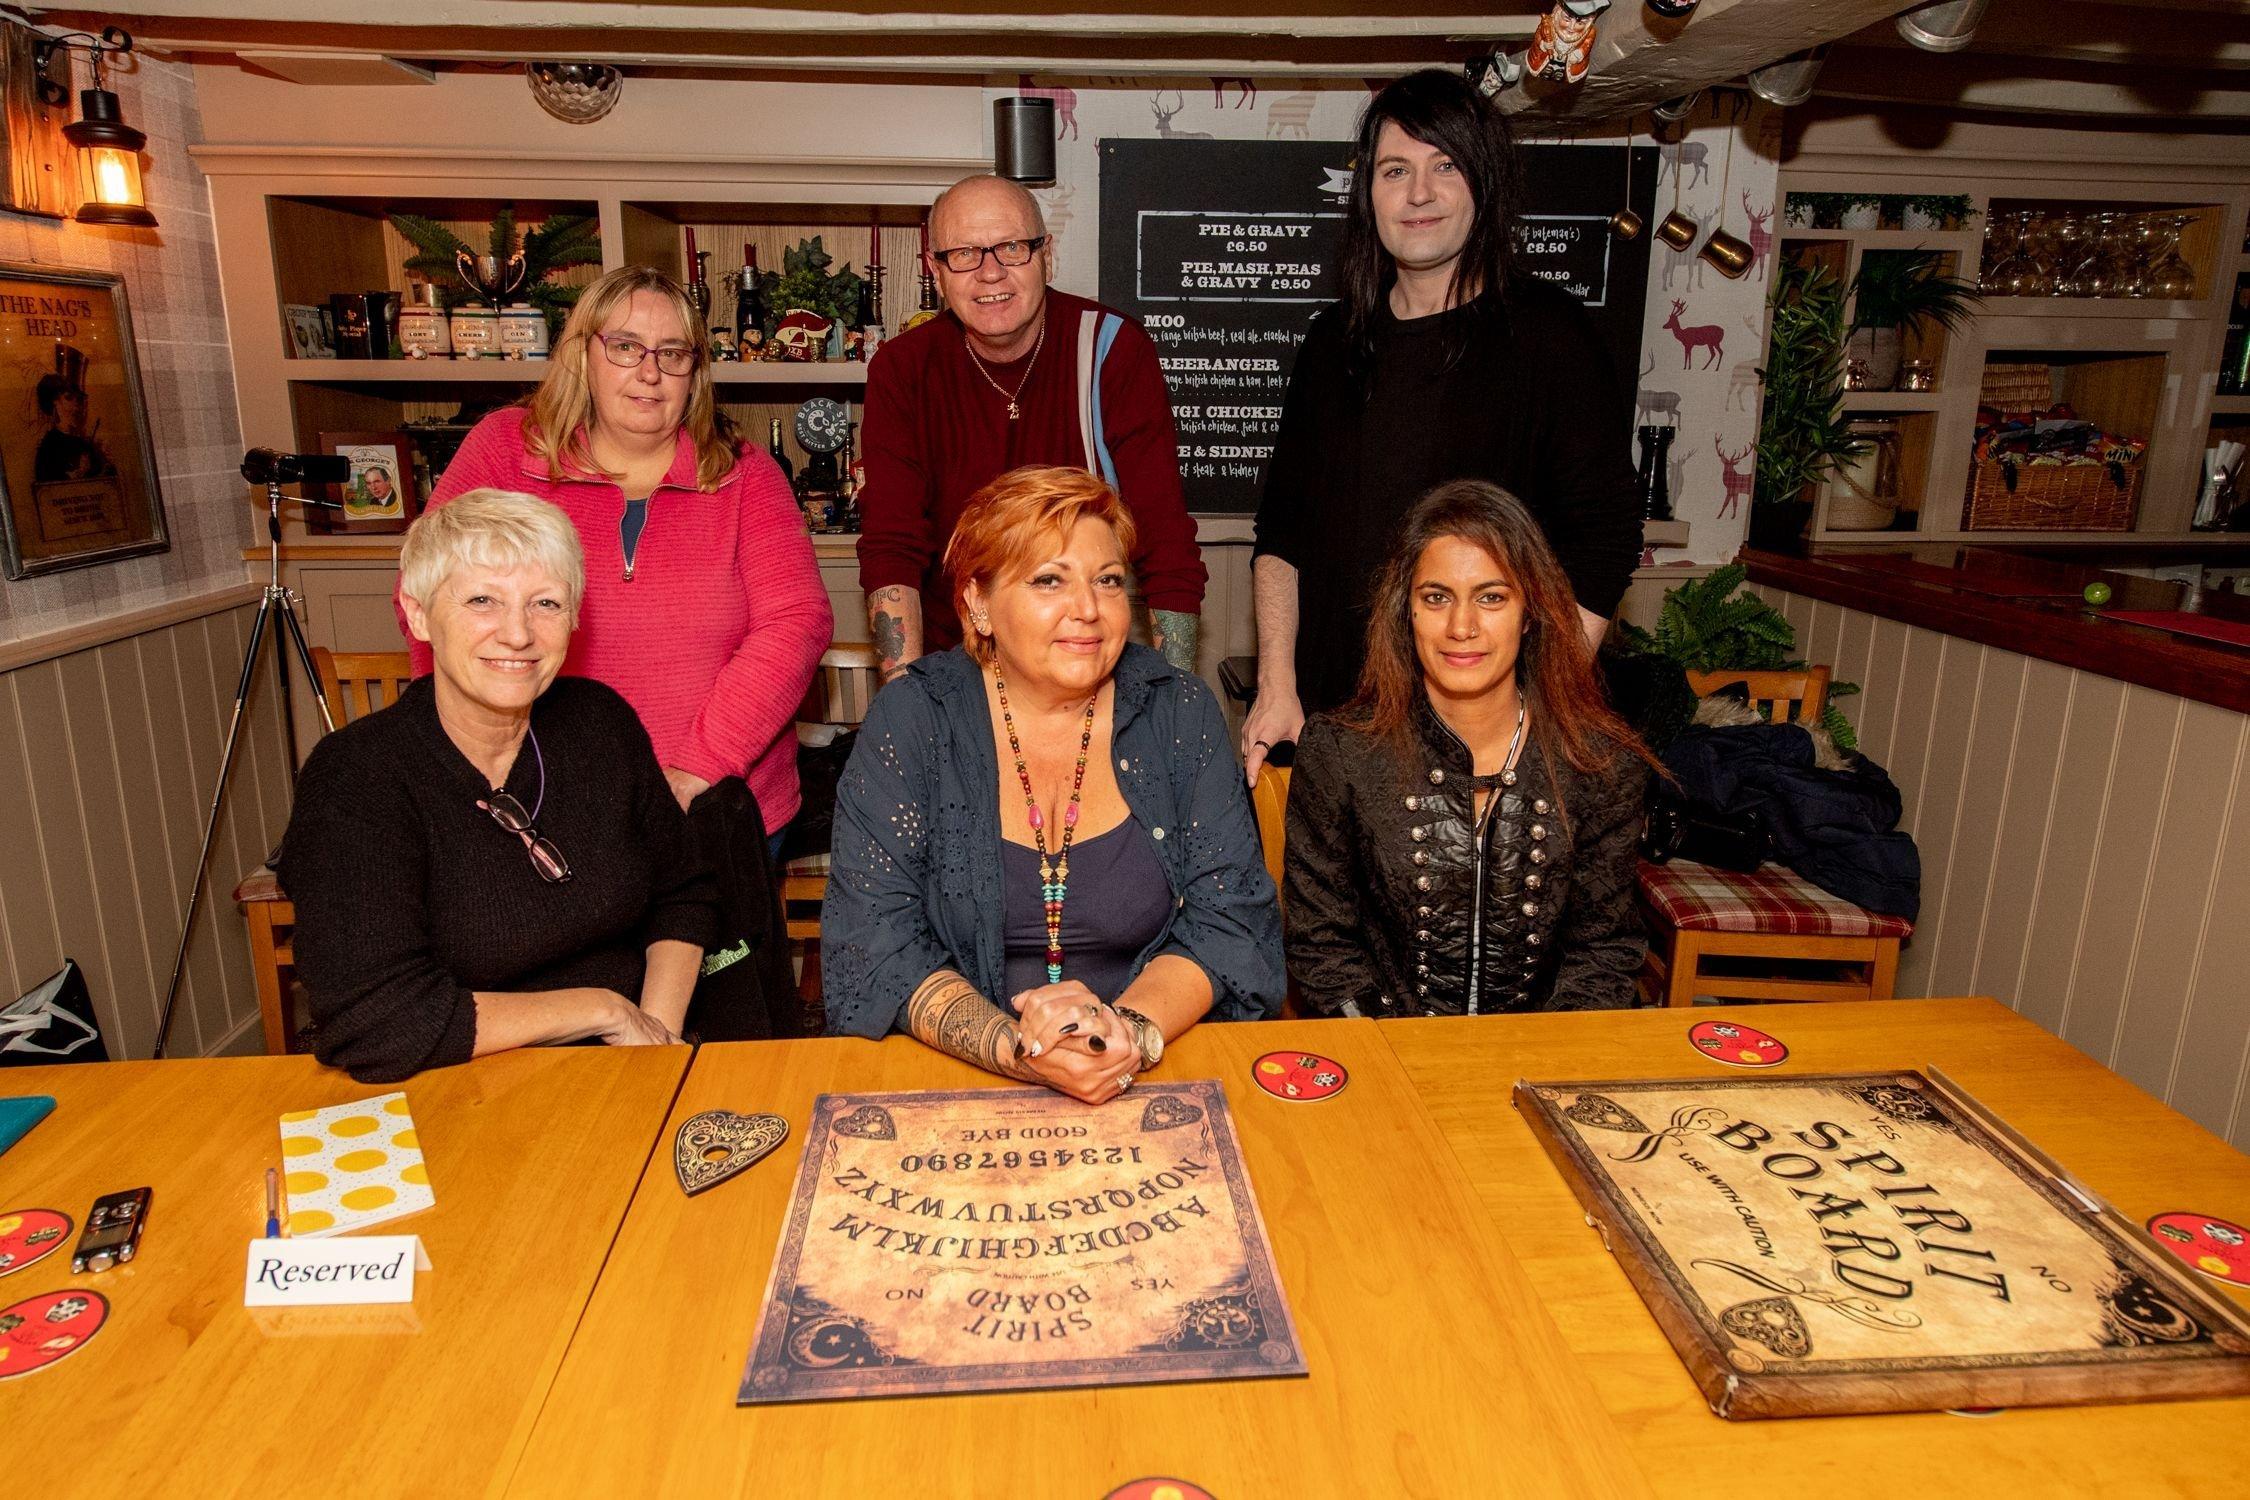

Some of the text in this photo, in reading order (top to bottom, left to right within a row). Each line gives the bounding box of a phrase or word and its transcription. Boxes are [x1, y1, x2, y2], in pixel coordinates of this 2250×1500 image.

[1199, 224, 1312, 237] PIE & GRAVY
[1226, 241, 1268, 252] £6.50
[1526, 242, 1567, 253] £8.50
[1181, 261, 1321, 276] PIE, MASH, PEAS
[1181, 276, 1311, 289] & GRAVY £9.50
[0, 295, 92, 318] THE NAG'S
[26, 318, 77, 337] HEAD
[1144, 315, 1185, 328] MOO
[1161, 329, 1182, 348] range
[1183, 327, 1207, 343] british
[1264, 329, 1290, 344] cracked
[1159, 357, 1280, 371] REERANGER
[1185, 374, 1208, 388] british
[1210, 373, 1236, 389] chicken
[1267, 374, 1283, 388] leek
[797, 399, 847, 448] BLACK SHEEP
[1181, 420, 1206, 434] british
[804, 438, 826, 449] BITTER
[1194, 446, 1206, 457] &
[1193, 463, 1215, 477] steak
[1229, 463, 1259, 484] kidney
[961, 1126, 1088, 1143] GOOD BYE
[1868, 1116, 1903, 1141] YES
[901, 1146, 1142, 1172] 1234567890
[1678, 1152, 1777, 1259] USE WITH CAUTION
[1707, 1119, 1913, 1301] BOARD
[1790, 1121, 2013, 1303] SPIRIT
[256, 1252, 405, 1291] Reserved
[2031, 1266, 2072, 1294] NO
[1130, 1278, 1175, 1291] YES
[885, 1288, 924, 1301] NO
[968, 1285, 1092, 1314] BOARD
[963, 1310, 1092, 1342] SPIRIT
